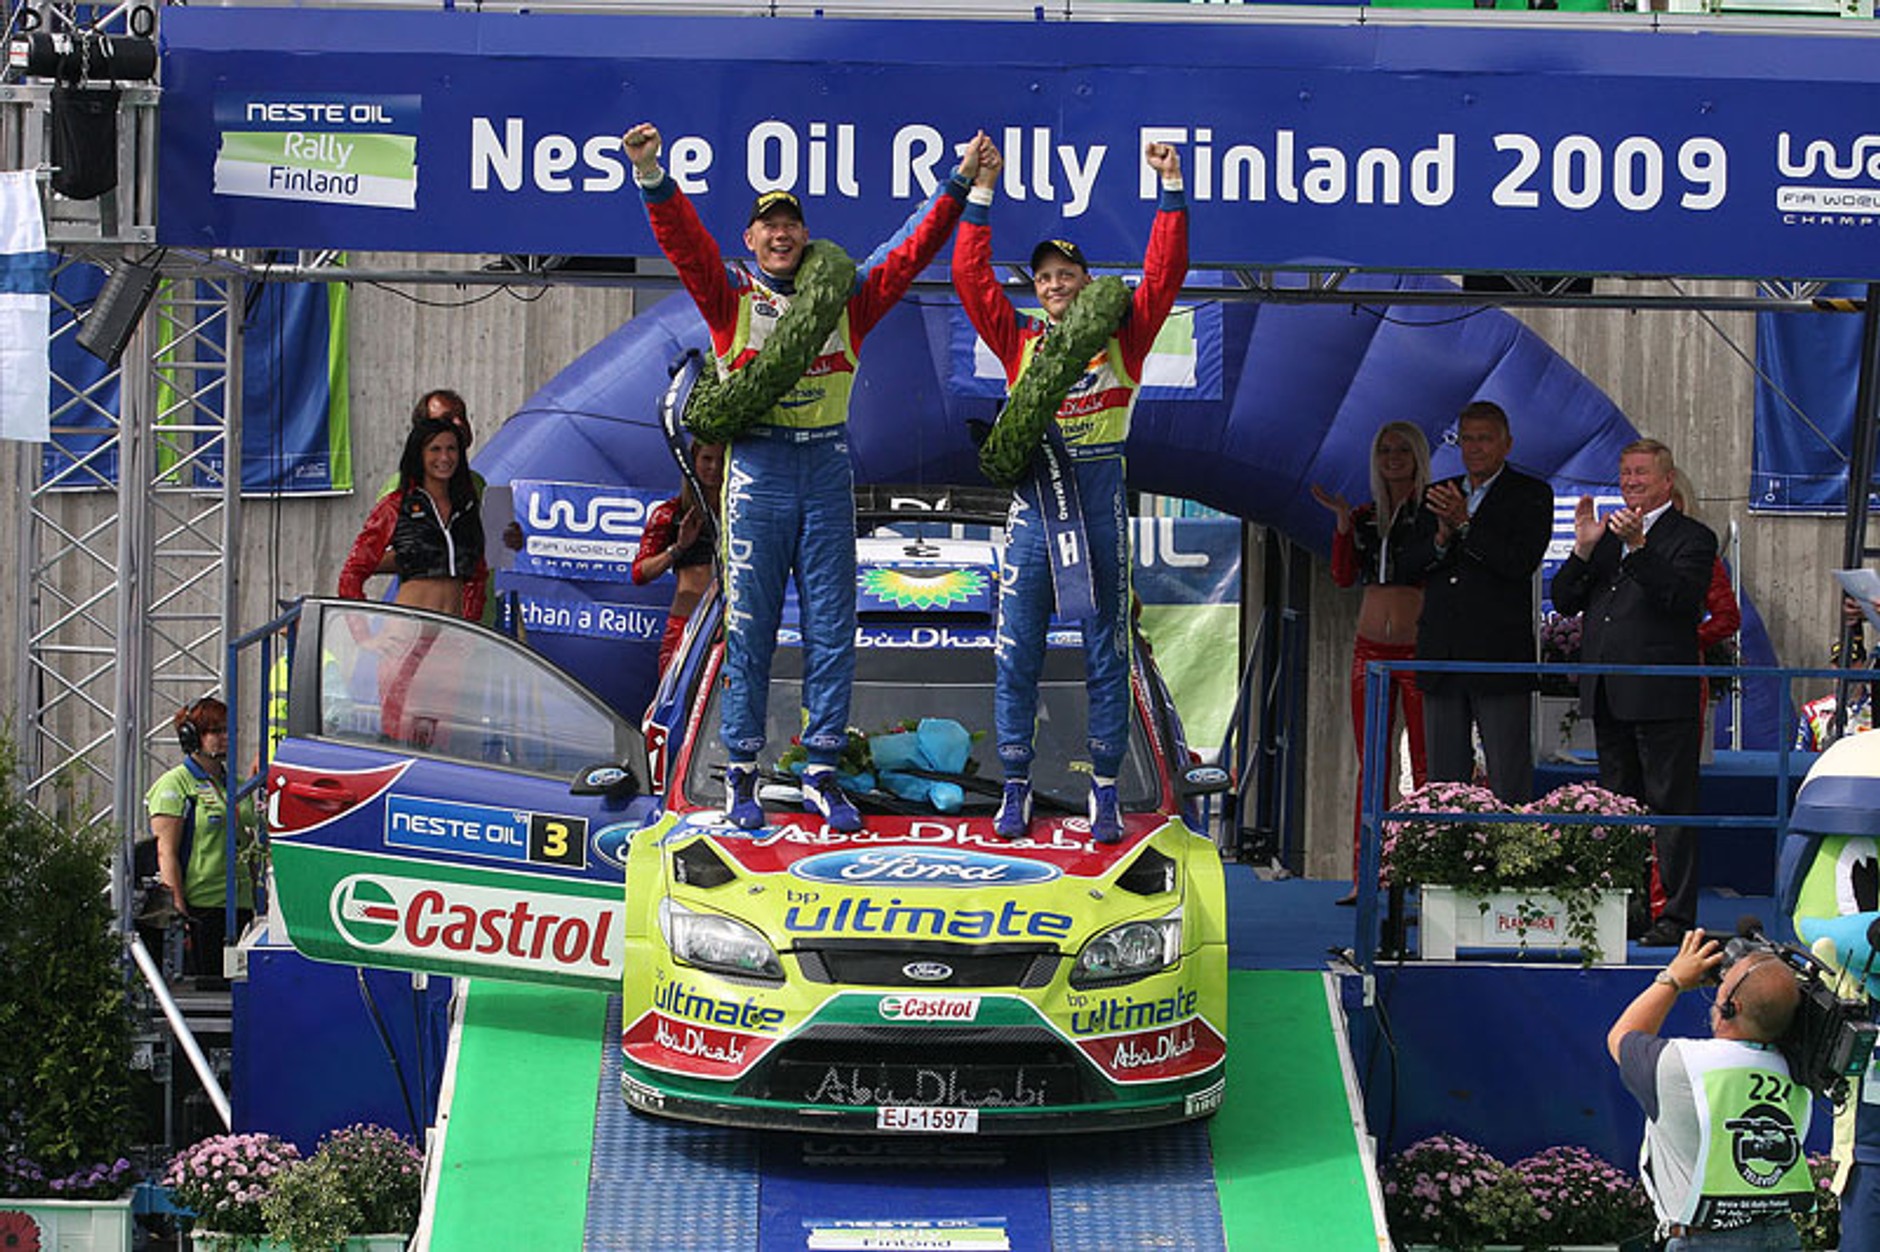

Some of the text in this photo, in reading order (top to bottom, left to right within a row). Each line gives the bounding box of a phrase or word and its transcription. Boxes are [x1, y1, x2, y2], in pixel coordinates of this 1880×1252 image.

[246, 102, 394, 124] NESTE OIL
[283, 131, 355, 170] Rally
[268, 165, 360, 196] Finland
[746, 119, 860, 198] Oil
[891, 124, 1108, 218] Rlly
[1138, 125, 1455, 207] Finland
[1490, 132, 1728, 212] 2009
[1783, 192, 1816, 204] FIA
[564, 544, 629, 557] WORLD
[519, 602, 571, 627] than
[578, 609, 591, 629] a
[599, 608, 660, 638] Rally.
[392, 813, 481, 842] NESTE
[485, 822, 524, 847] OIL
[542, 822, 569, 858] 3
[840, 852, 1010, 883] Ford
[787, 889, 820, 905] bp
[404, 889, 614, 968] Castrol
[784, 897, 1074, 939] ultimate
[653, 981, 786, 1032] ultimate
[903, 998, 974, 1018] Castrol
[1071, 985, 1198, 1034] ultimate
[917, 1067, 1048, 1106] Dhabi
[883, 1108, 969, 1128] EJ-1597
